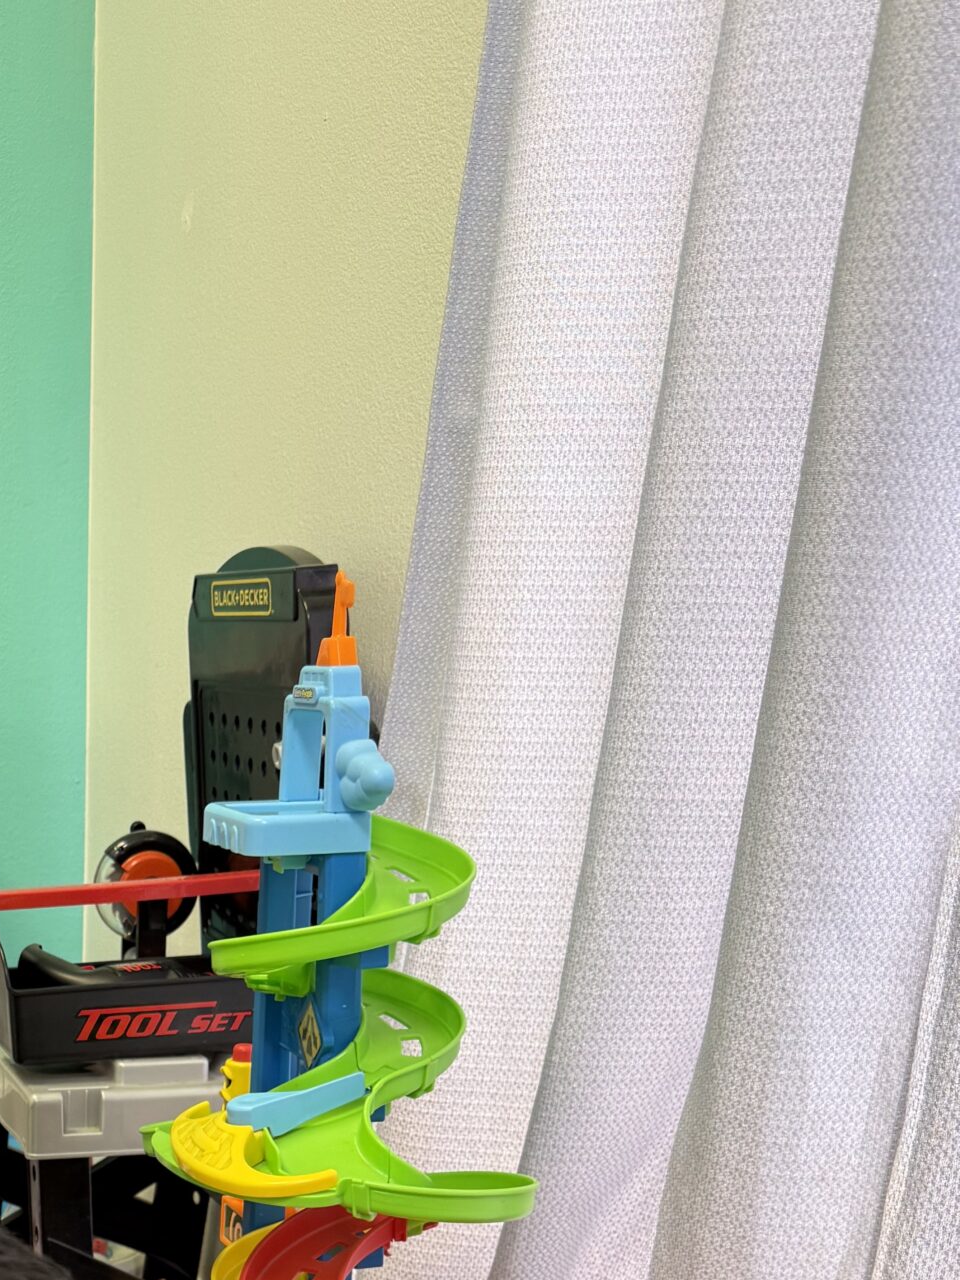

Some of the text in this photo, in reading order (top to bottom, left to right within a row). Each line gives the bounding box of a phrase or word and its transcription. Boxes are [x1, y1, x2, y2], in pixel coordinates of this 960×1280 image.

[214, 589, 269, 607] BLACK+DECKER
[75, 1001, 252, 1042] TOOL SET
